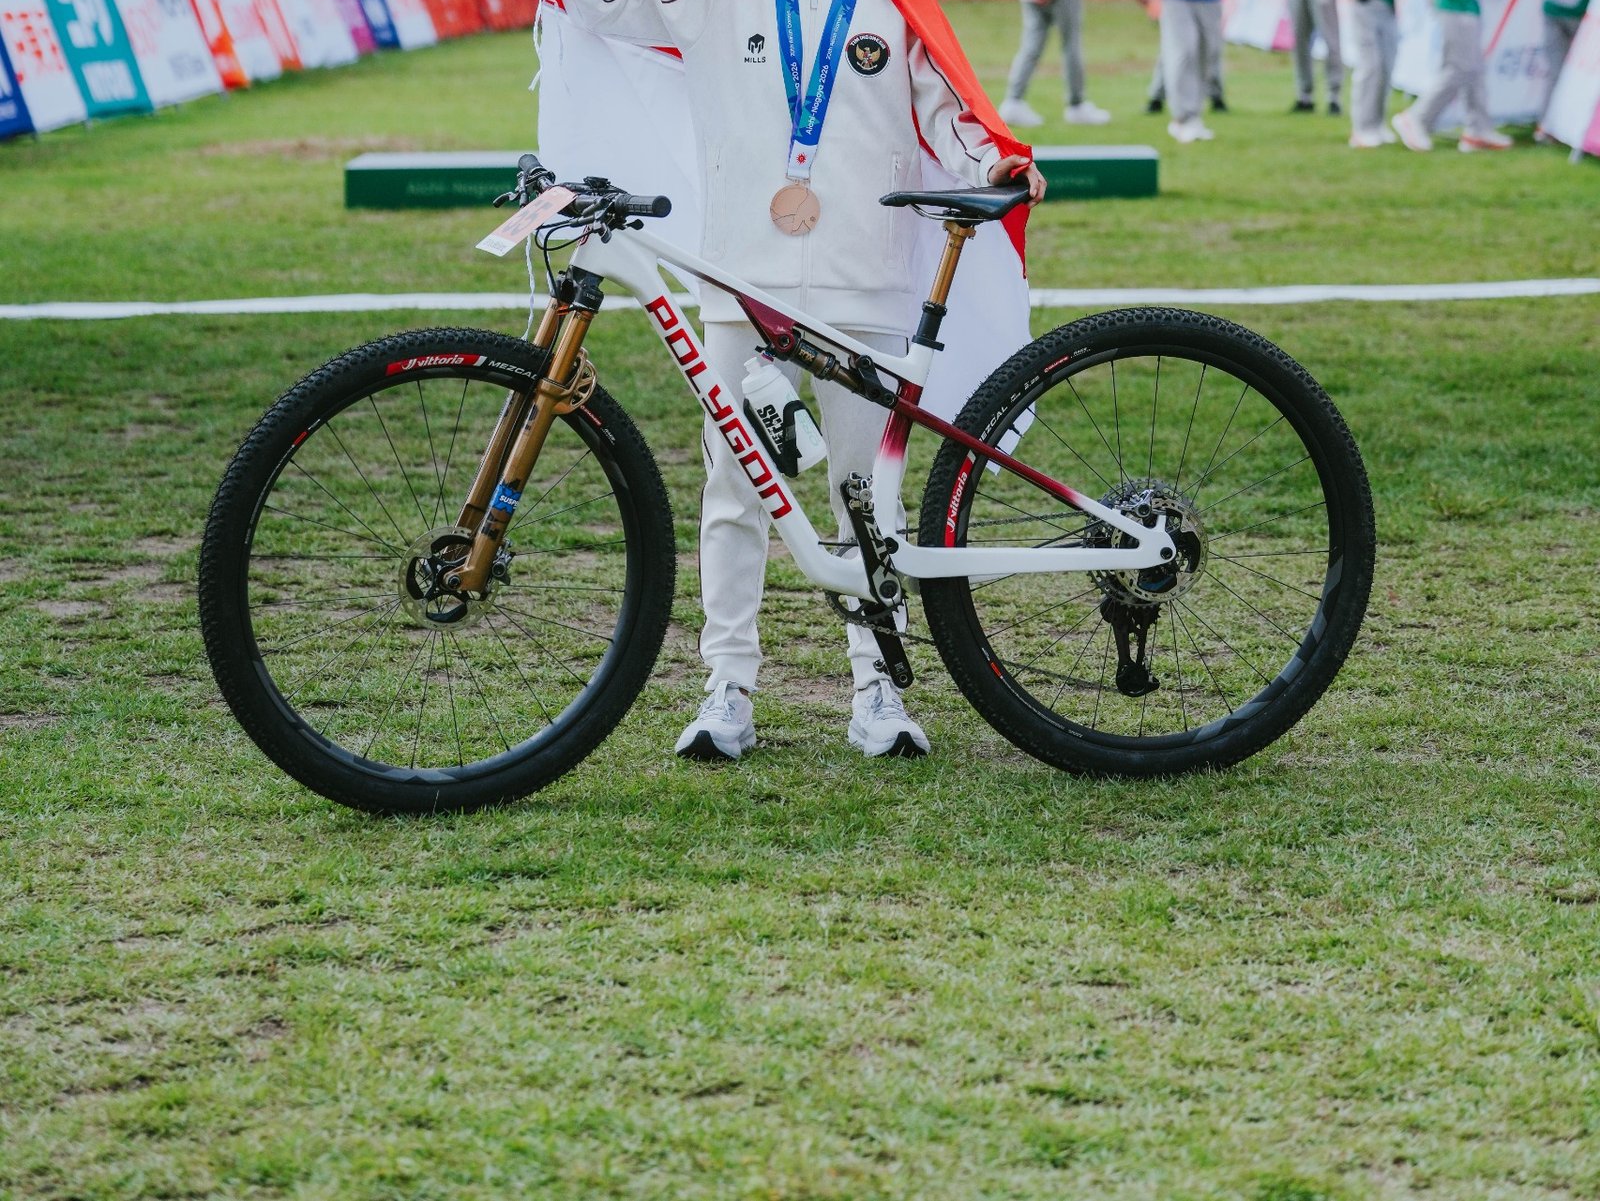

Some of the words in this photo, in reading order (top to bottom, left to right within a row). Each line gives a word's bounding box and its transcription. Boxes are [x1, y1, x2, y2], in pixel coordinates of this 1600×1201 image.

[744, 56, 767, 64] MILLS
[791, 62, 799, 80] 2026
[818, 64, 829, 83] 2026
[417, 354, 464, 368] vittoria
[488, 360, 538, 381] MEZCAL
[645, 295, 792, 519] POLYGON
[951, 471, 968, 519] vittoria
[979, 405, 1008, 442] EZCAL
